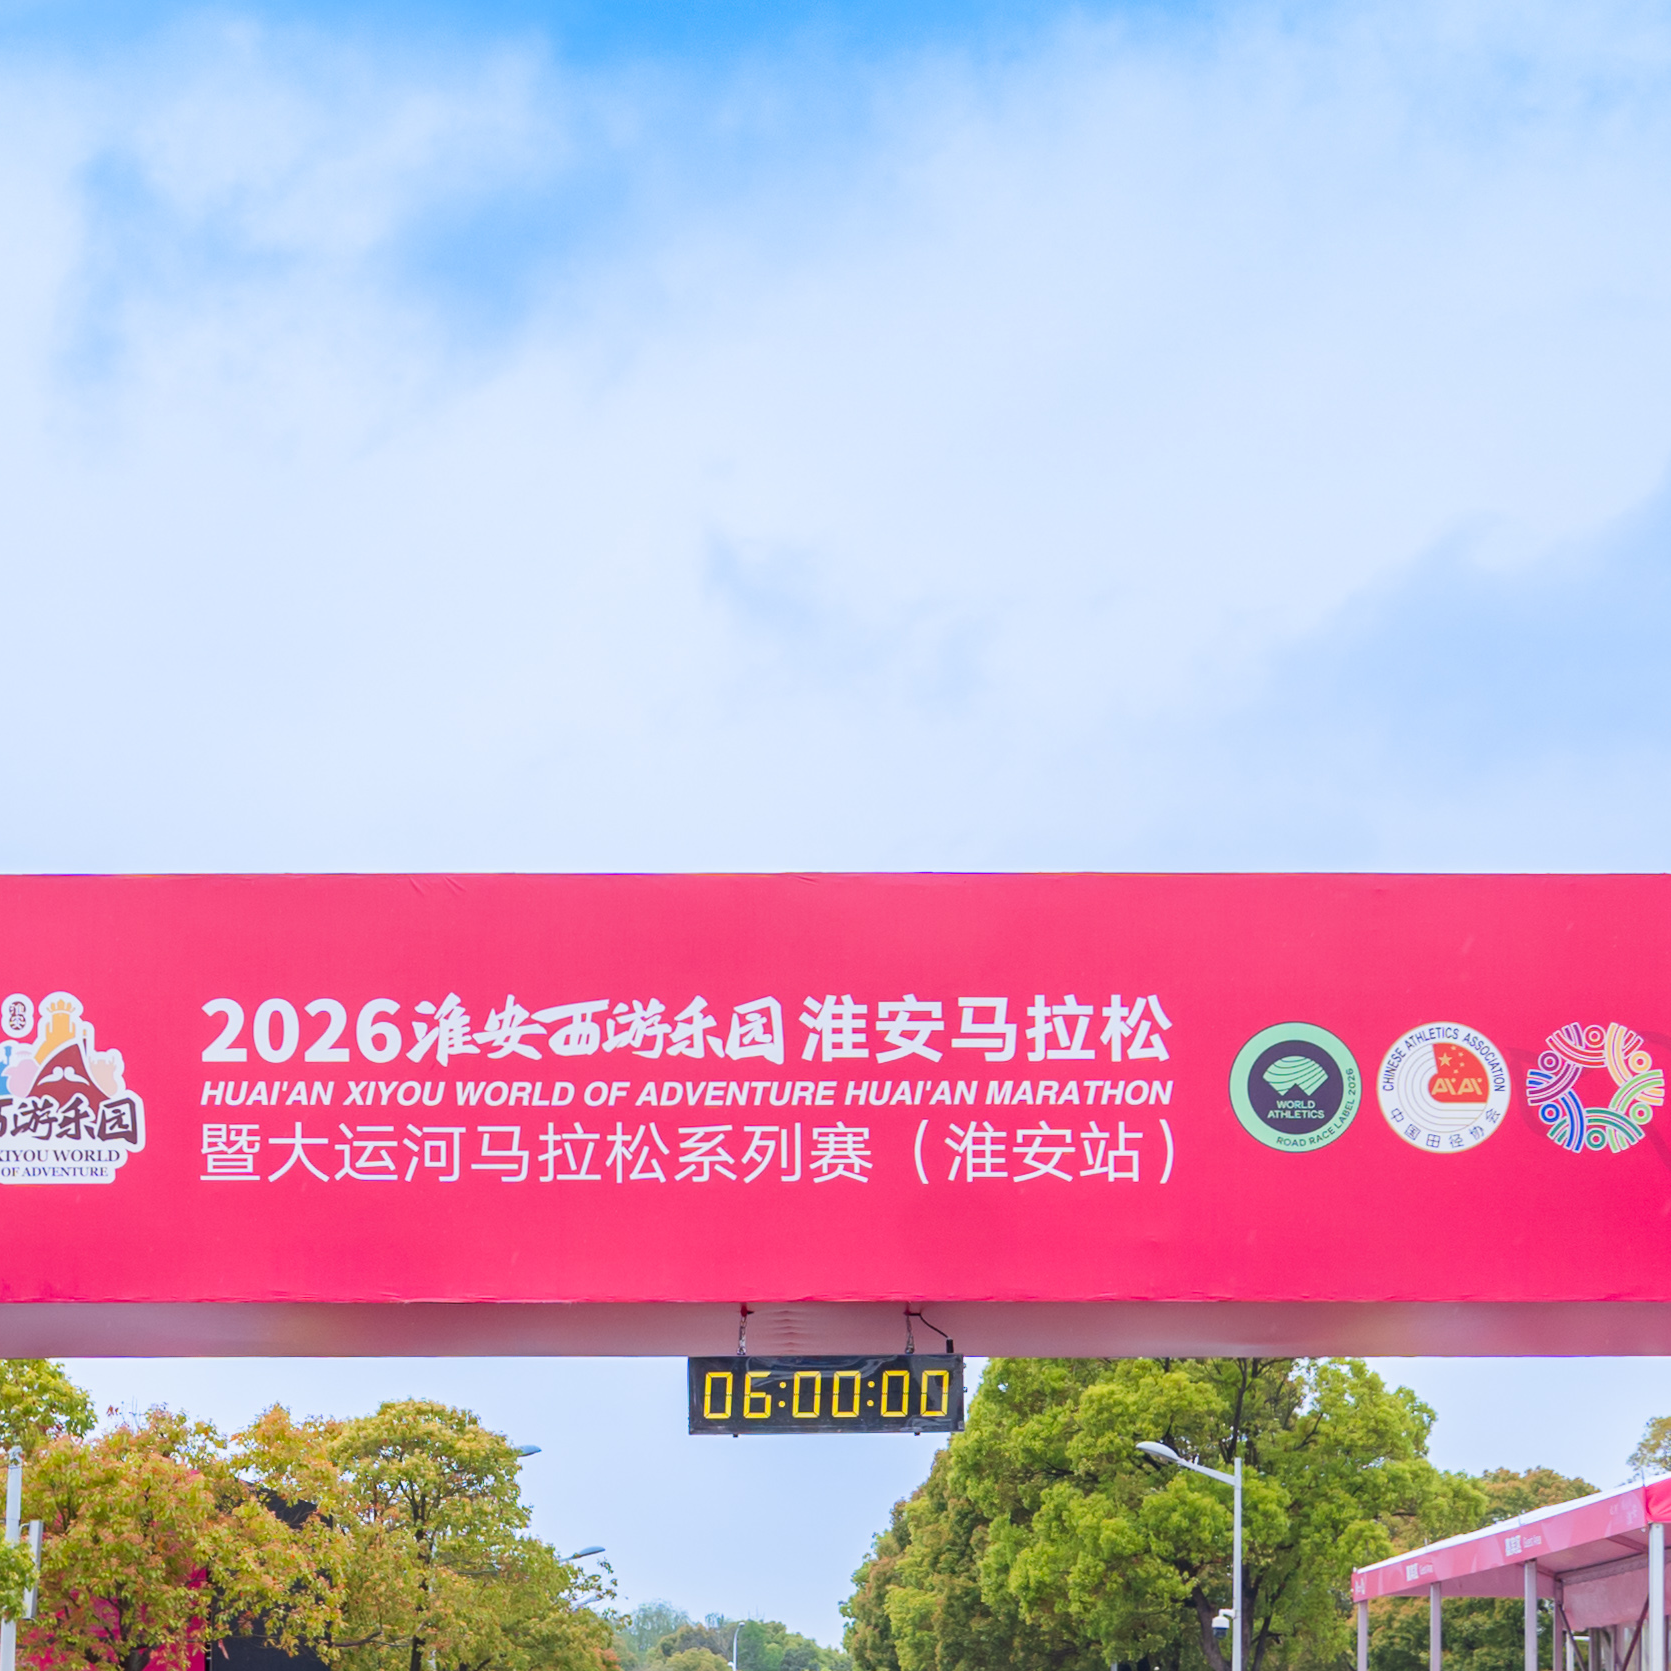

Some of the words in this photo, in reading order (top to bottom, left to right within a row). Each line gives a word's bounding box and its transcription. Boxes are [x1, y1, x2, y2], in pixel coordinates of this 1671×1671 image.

[1382, 1047, 1407, 1092] CHINESE
[1404, 1027, 1460, 1050] ATHLETICS
[1462, 1033, 1506, 1092] ASSOCIATION
[200, 1080, 334, 1107] HUAI'AN
[343, 1080, 446, 1107] XIYOU
[466, 1080, 575, 1107] WORLD
[583, 1080, 629, 1107] OF
[635, 1080, 837, 1107] ADVENTURE
[844, 1080, 978, 1107] HUAI'AN
[985, 1080, 1173, 1107] MARATHON
[1277, 1100, 1316, 1109] WORLD
[1267, 1110, 1325, 1119] ATHLETICS
[1276, 1136, 1307, 1147] ROAD
[1309, 1126, 1336, 1144] RACE
[1334, 1099, 1355, 1128] LABEL
[1345, 1068, 1357, 1096] 2026
[1391, 1108, 1501, 1148] 中国田径协会
[53, 1149, 120, 1162] WORLD
[1, 1167, 20, 1177] OF
[23, 1167, 108, 1177] ADVENTURE
[703, 1370, 950, 1419] 06:00:00
